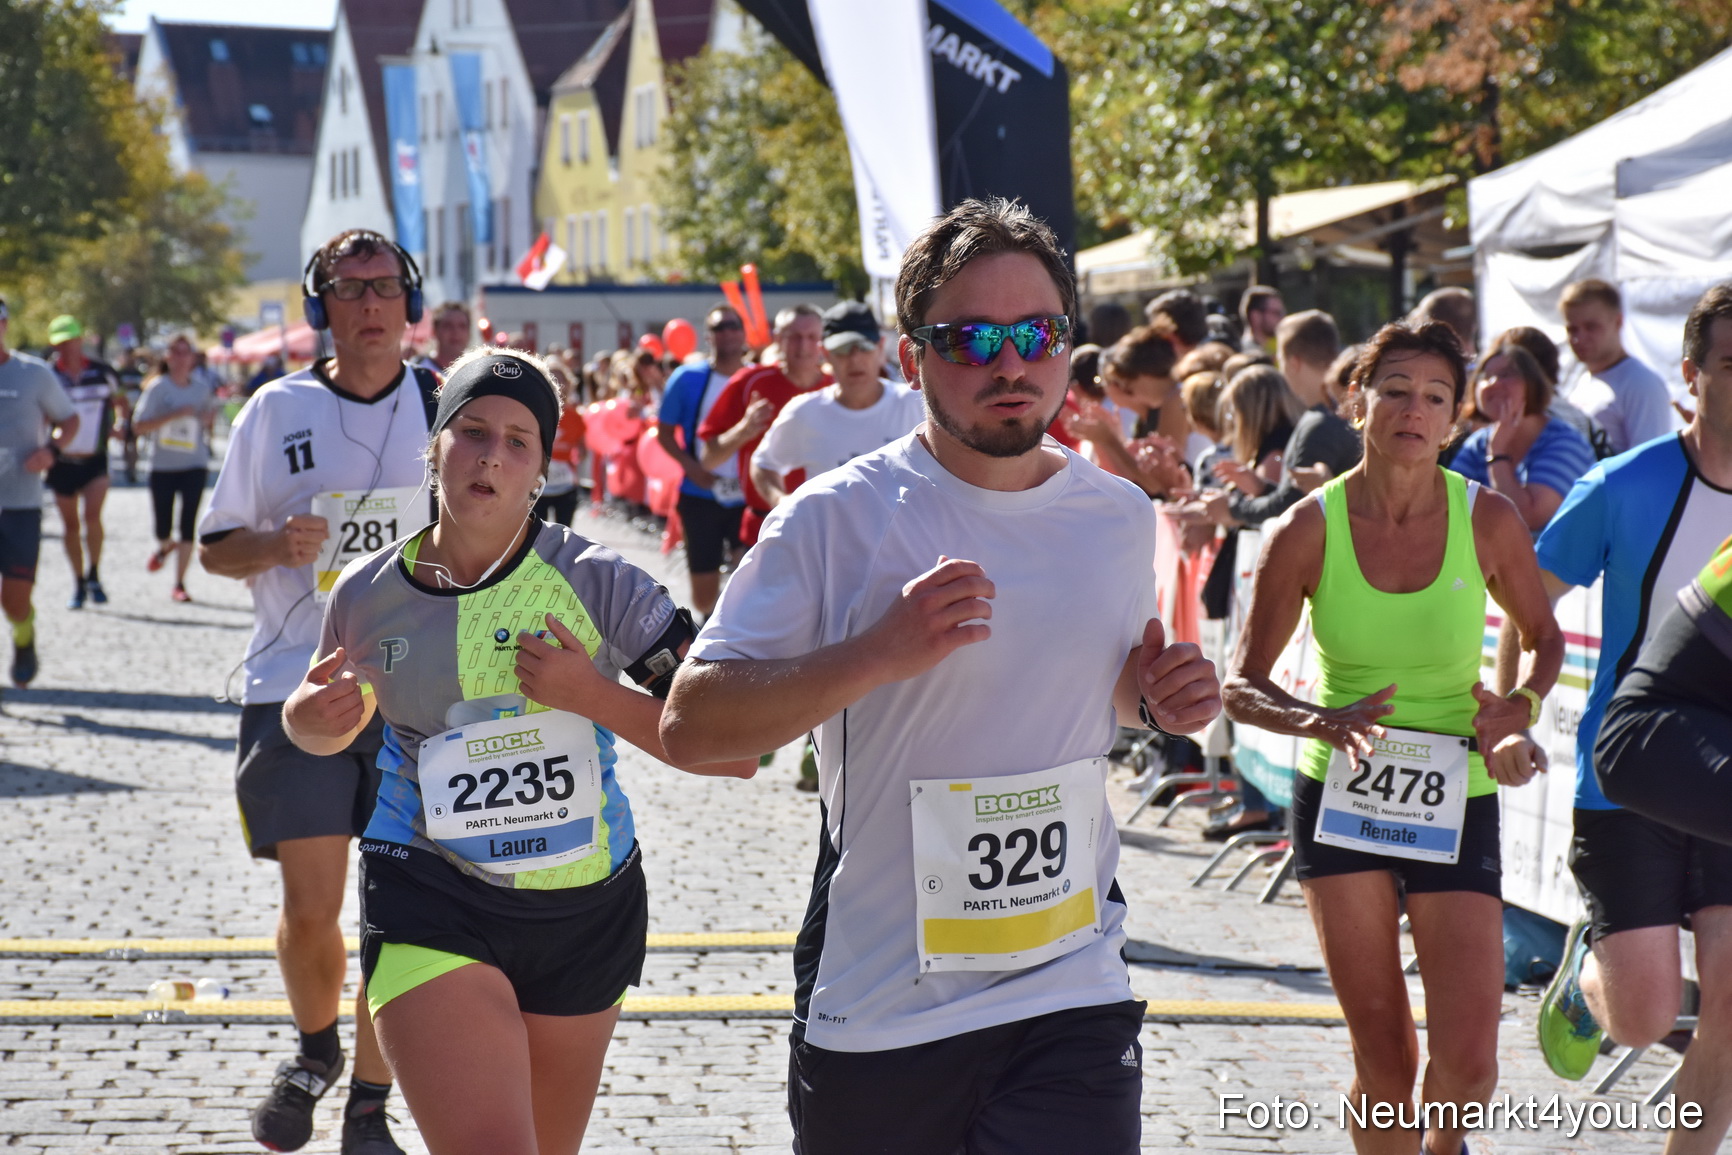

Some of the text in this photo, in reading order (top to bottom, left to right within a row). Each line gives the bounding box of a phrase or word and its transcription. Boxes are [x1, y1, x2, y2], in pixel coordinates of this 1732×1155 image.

[498, 363, 519, 375] Buff
[284, 440, 315, 474] 11
[340, 518, 398, 553] 281
[466, 728, 543, 757] BOCK
[1373, 738, 1432, 759] BOCK
[468, 745, 545, 764] inspired by smart concepts
[448, 755, 575, 814] 2235
[1346, 759, 1445, 806] 2478
[975, 784, 1061, 815] BOCK
[1352, 801, 1421, 819] PARTL Neumarkt
[466, 811, 554, 830] PARTL Neumarkt
[975, 805, 1062, 824] inspired by smart concepts
[1360, 820, 1417, 844] Renate
[490, 836, 547, 858] Laura
[968, 821, 1067, 890] 329
[928, 879, 936, 890] C
[964, 887, 1060, 911] PARTL Neumarkt
[818, 1013, 847, 1024] DRI-FIT
